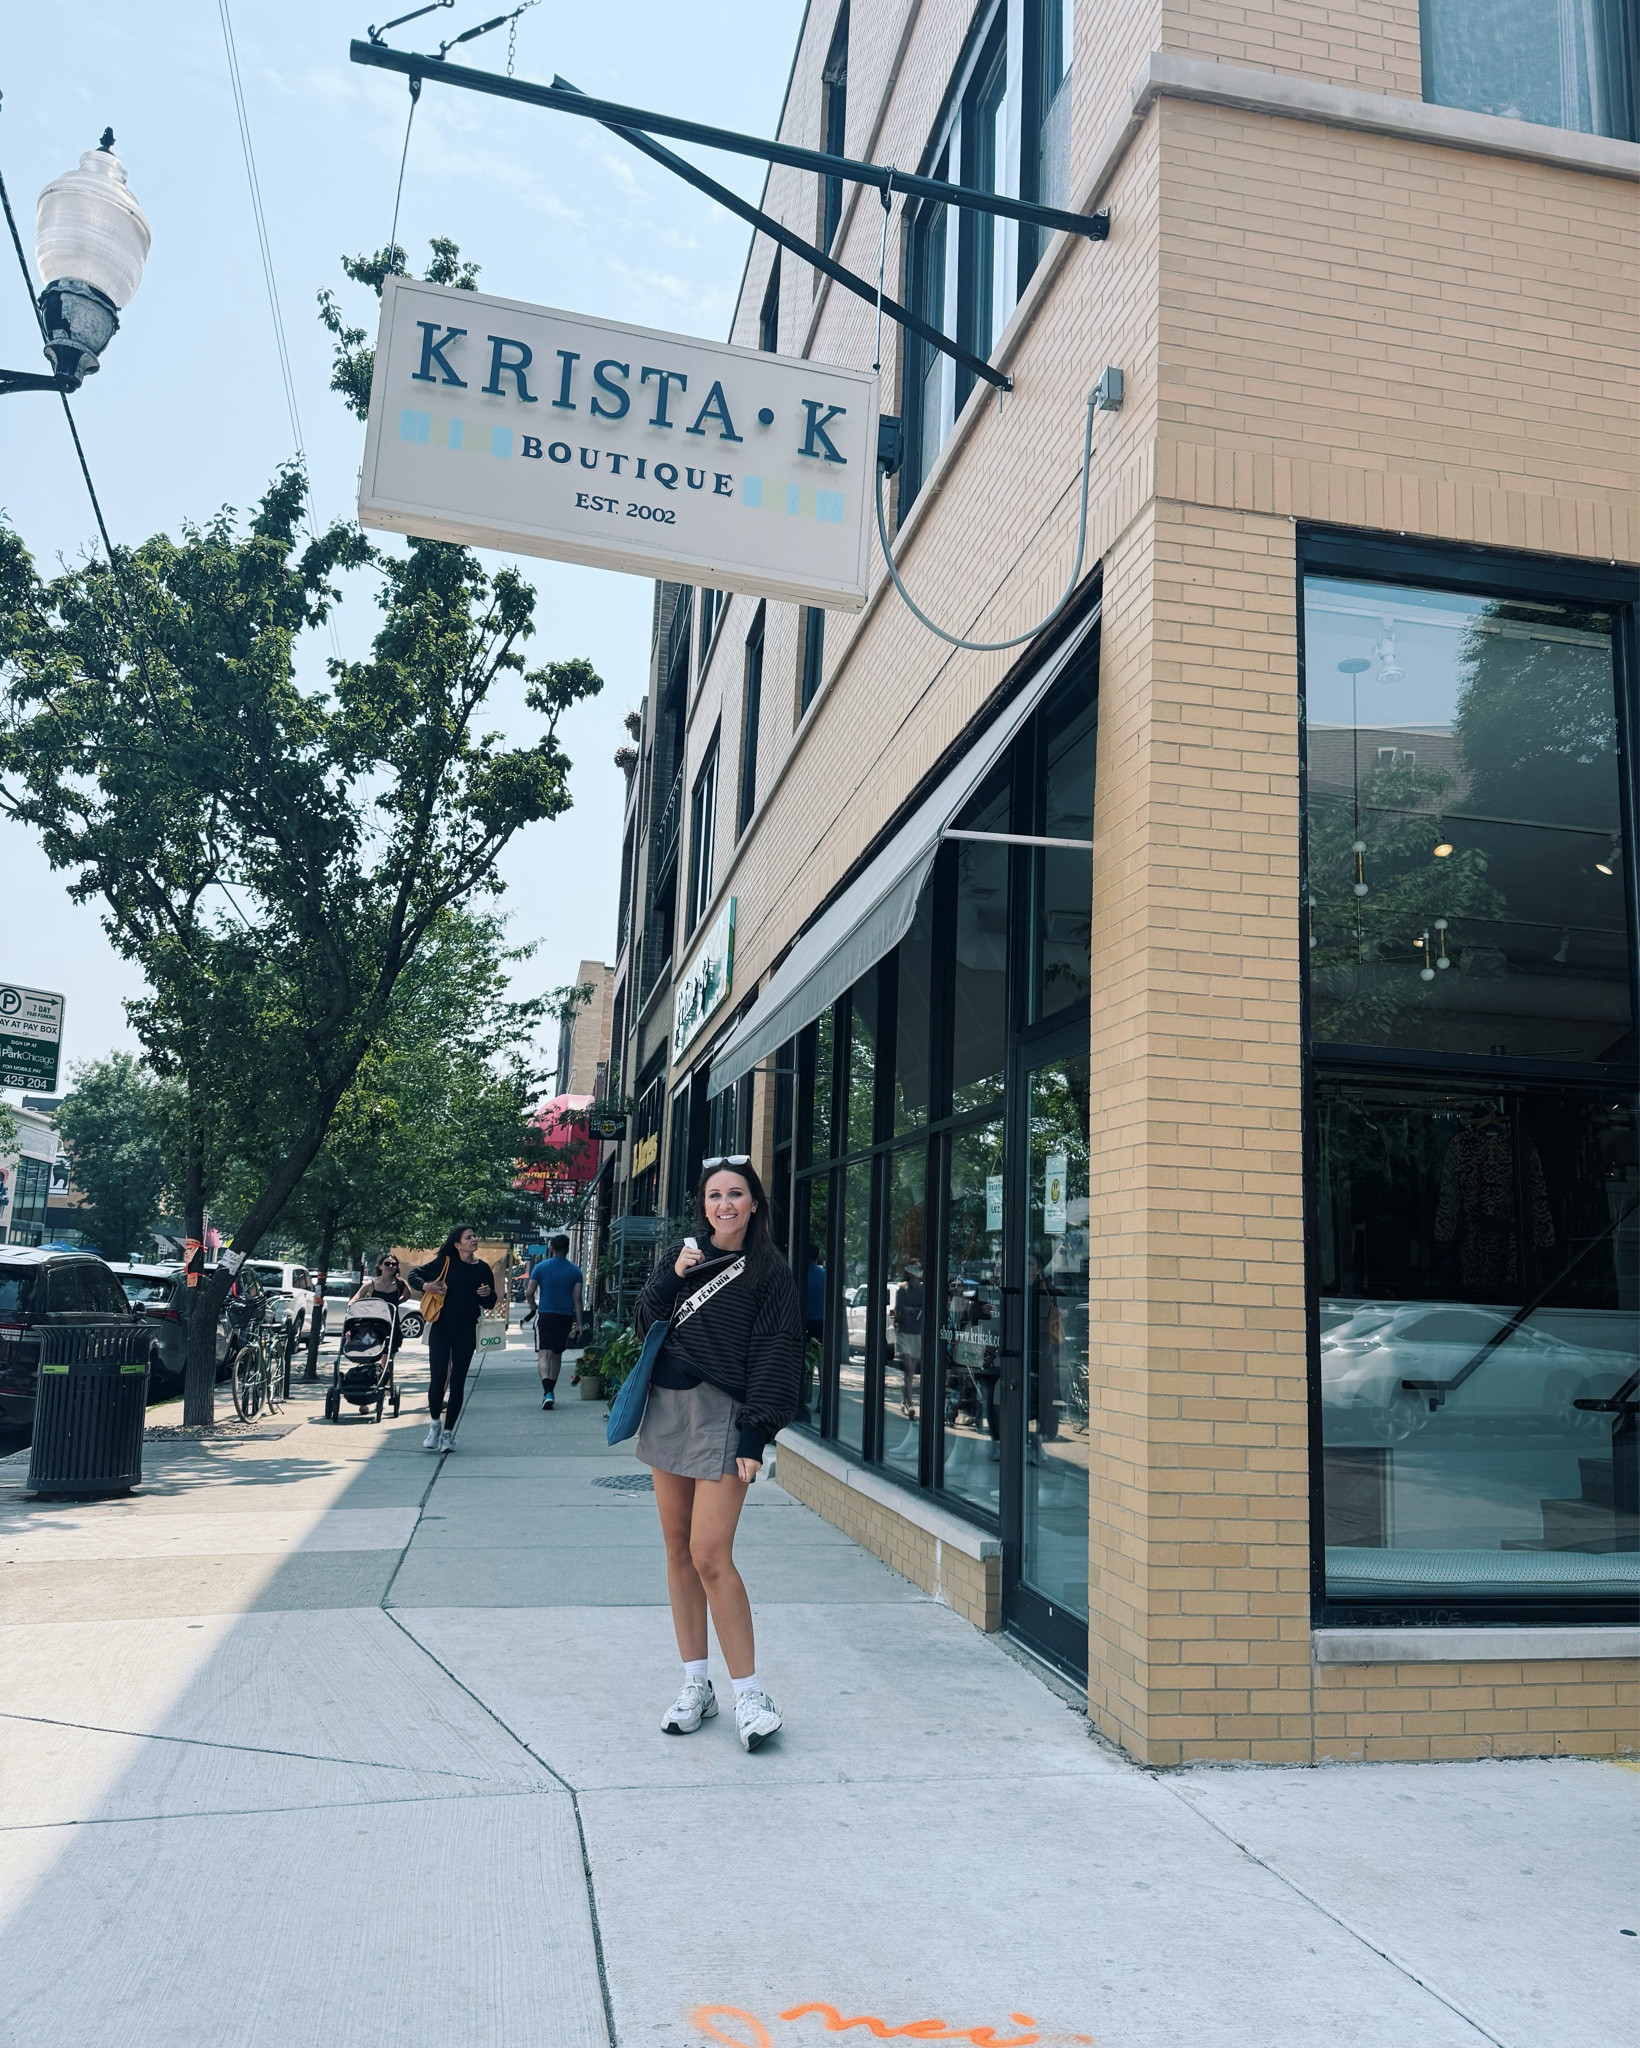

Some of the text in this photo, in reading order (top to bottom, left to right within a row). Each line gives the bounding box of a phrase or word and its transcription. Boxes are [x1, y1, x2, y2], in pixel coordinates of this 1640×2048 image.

[412, 321, 847, 465] KRISTA K
[521, 434, 734, 498] BOUTIQUE
[575, 492, 677, 525] EST. 2002
[38, 1005, 51, 1014] DAY
[0, 1018, 57, 1035] AY AT PAY BOX
[3, 1074, 47, 1090] 425 204
[940, 1324, 953, 1344] shop
